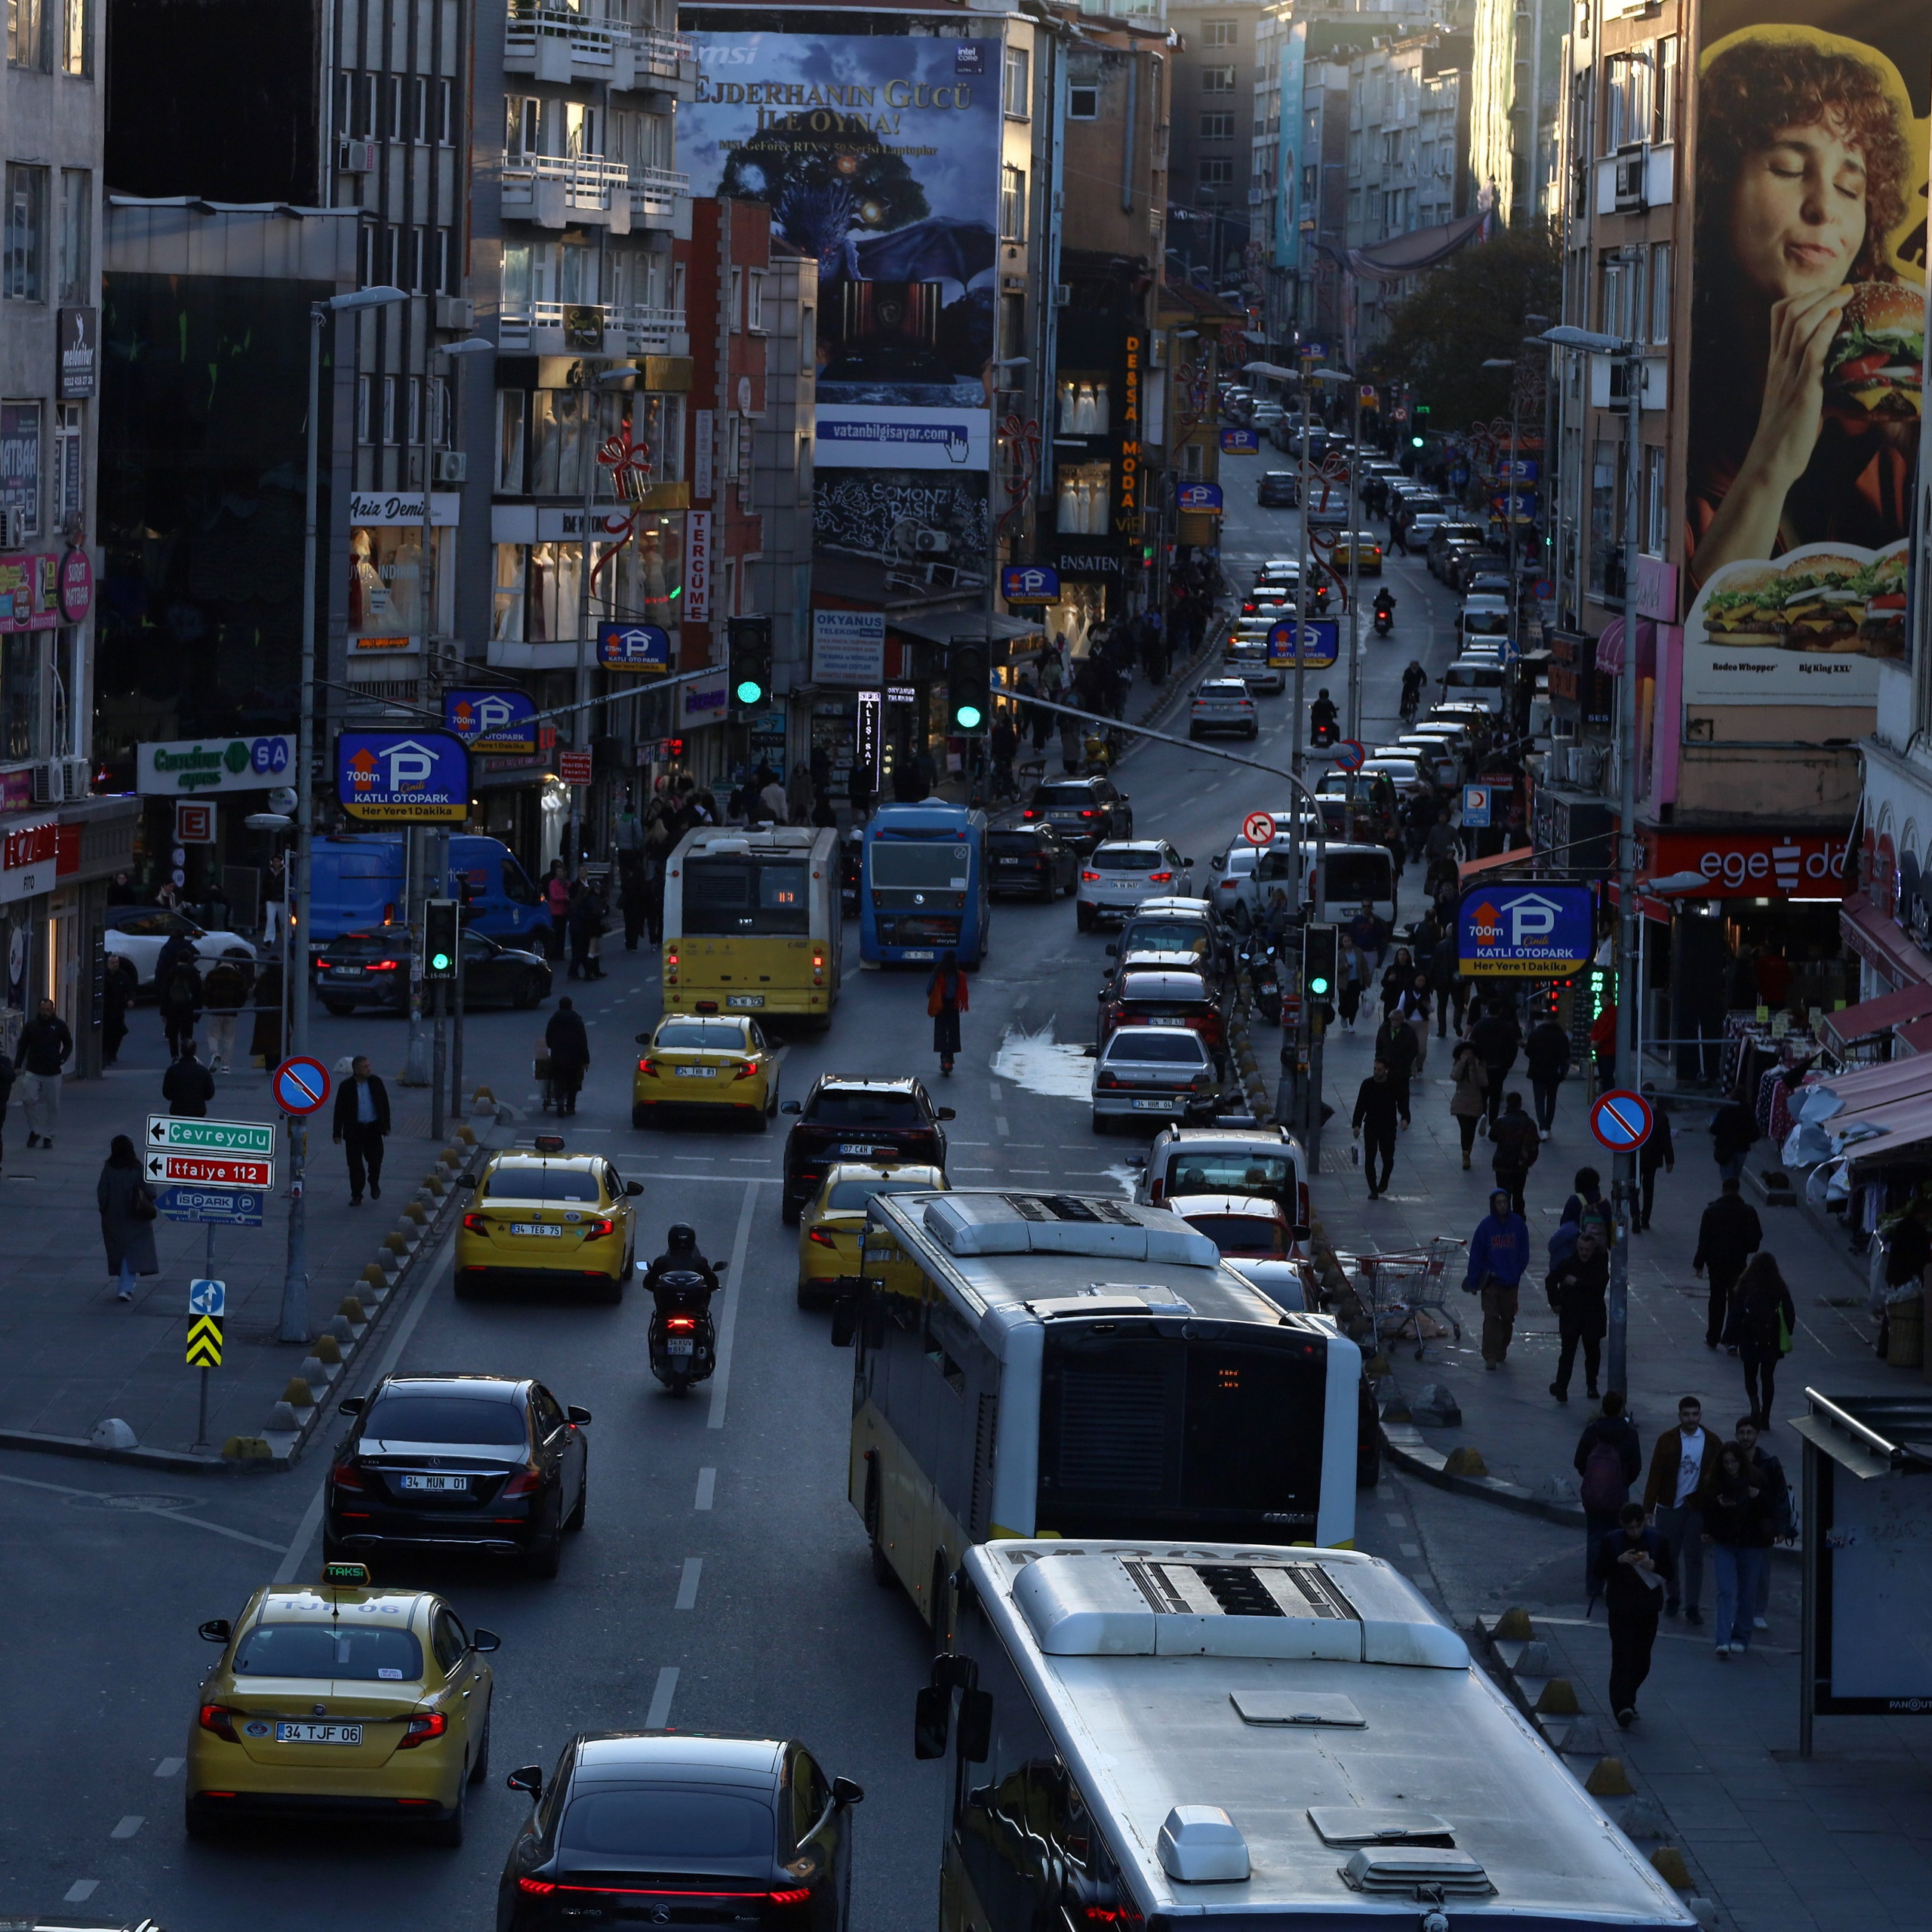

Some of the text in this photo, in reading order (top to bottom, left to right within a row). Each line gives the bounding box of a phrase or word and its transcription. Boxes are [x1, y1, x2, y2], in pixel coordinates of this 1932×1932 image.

[698, 47, 758, 65] msi
[958, 47, 976, 55] intel
[695, 74, 973, 110] EJDERHANIN GÜCÜ
[756, 105, 900, 136] İLE OYNA!
[746, 141, 790, 152] GeForce
[1124, 337, 1140, 421] DESSA
[833, 423, 949, 442] vatanbilgisayar.com
[1121, 441, 1138, 509] MODA
[350, 495, 381, 518] Aziz
[690, 513, 705, 620] TERCÜME
[1060, 555, 1119, 571] ENSATEN
[817, 614, 881, 626] OKYANUS
[819, 627, 859, 635] TELEKOM
[1712, 662, 1777, 673] Rodeo Whopper
[1798, 663, 1851, 675] Big King XXL
[453, 716, 476, 725] 700m
[346, 771, 381, 783] 700m
[354, 793, 449, 804] KATLI OTOPARK
[361, 806, 383, 816] Her
[383, 806, 408, 816] Yere
[415, 806, 453, 816] Dakika
[1700, 851, 1770, 889] ege
[1469, 925, 1504, 937] 700m
[1477, 948, 1574, 958] KATLI OTOPARK
[1474, 961, 1495, 971] Her
[1496, 961, 1521, 971] Yere
[1528, 961, 1567, 971] Dakika
[170, 1123, 267, 1147] Çevreyolu
[843, 1145, 852, 1153] 07
[168, 1157, 257, 1181] İtfaiye 112
[515, 1225, 560, 1235] 34 TEG 75
[406, 1476, 465, 1489] 34 MUN 01
[278, 1601, 400, 1614] TJF 06
[285, 1724, 358, 1742] 34 TJF 06
